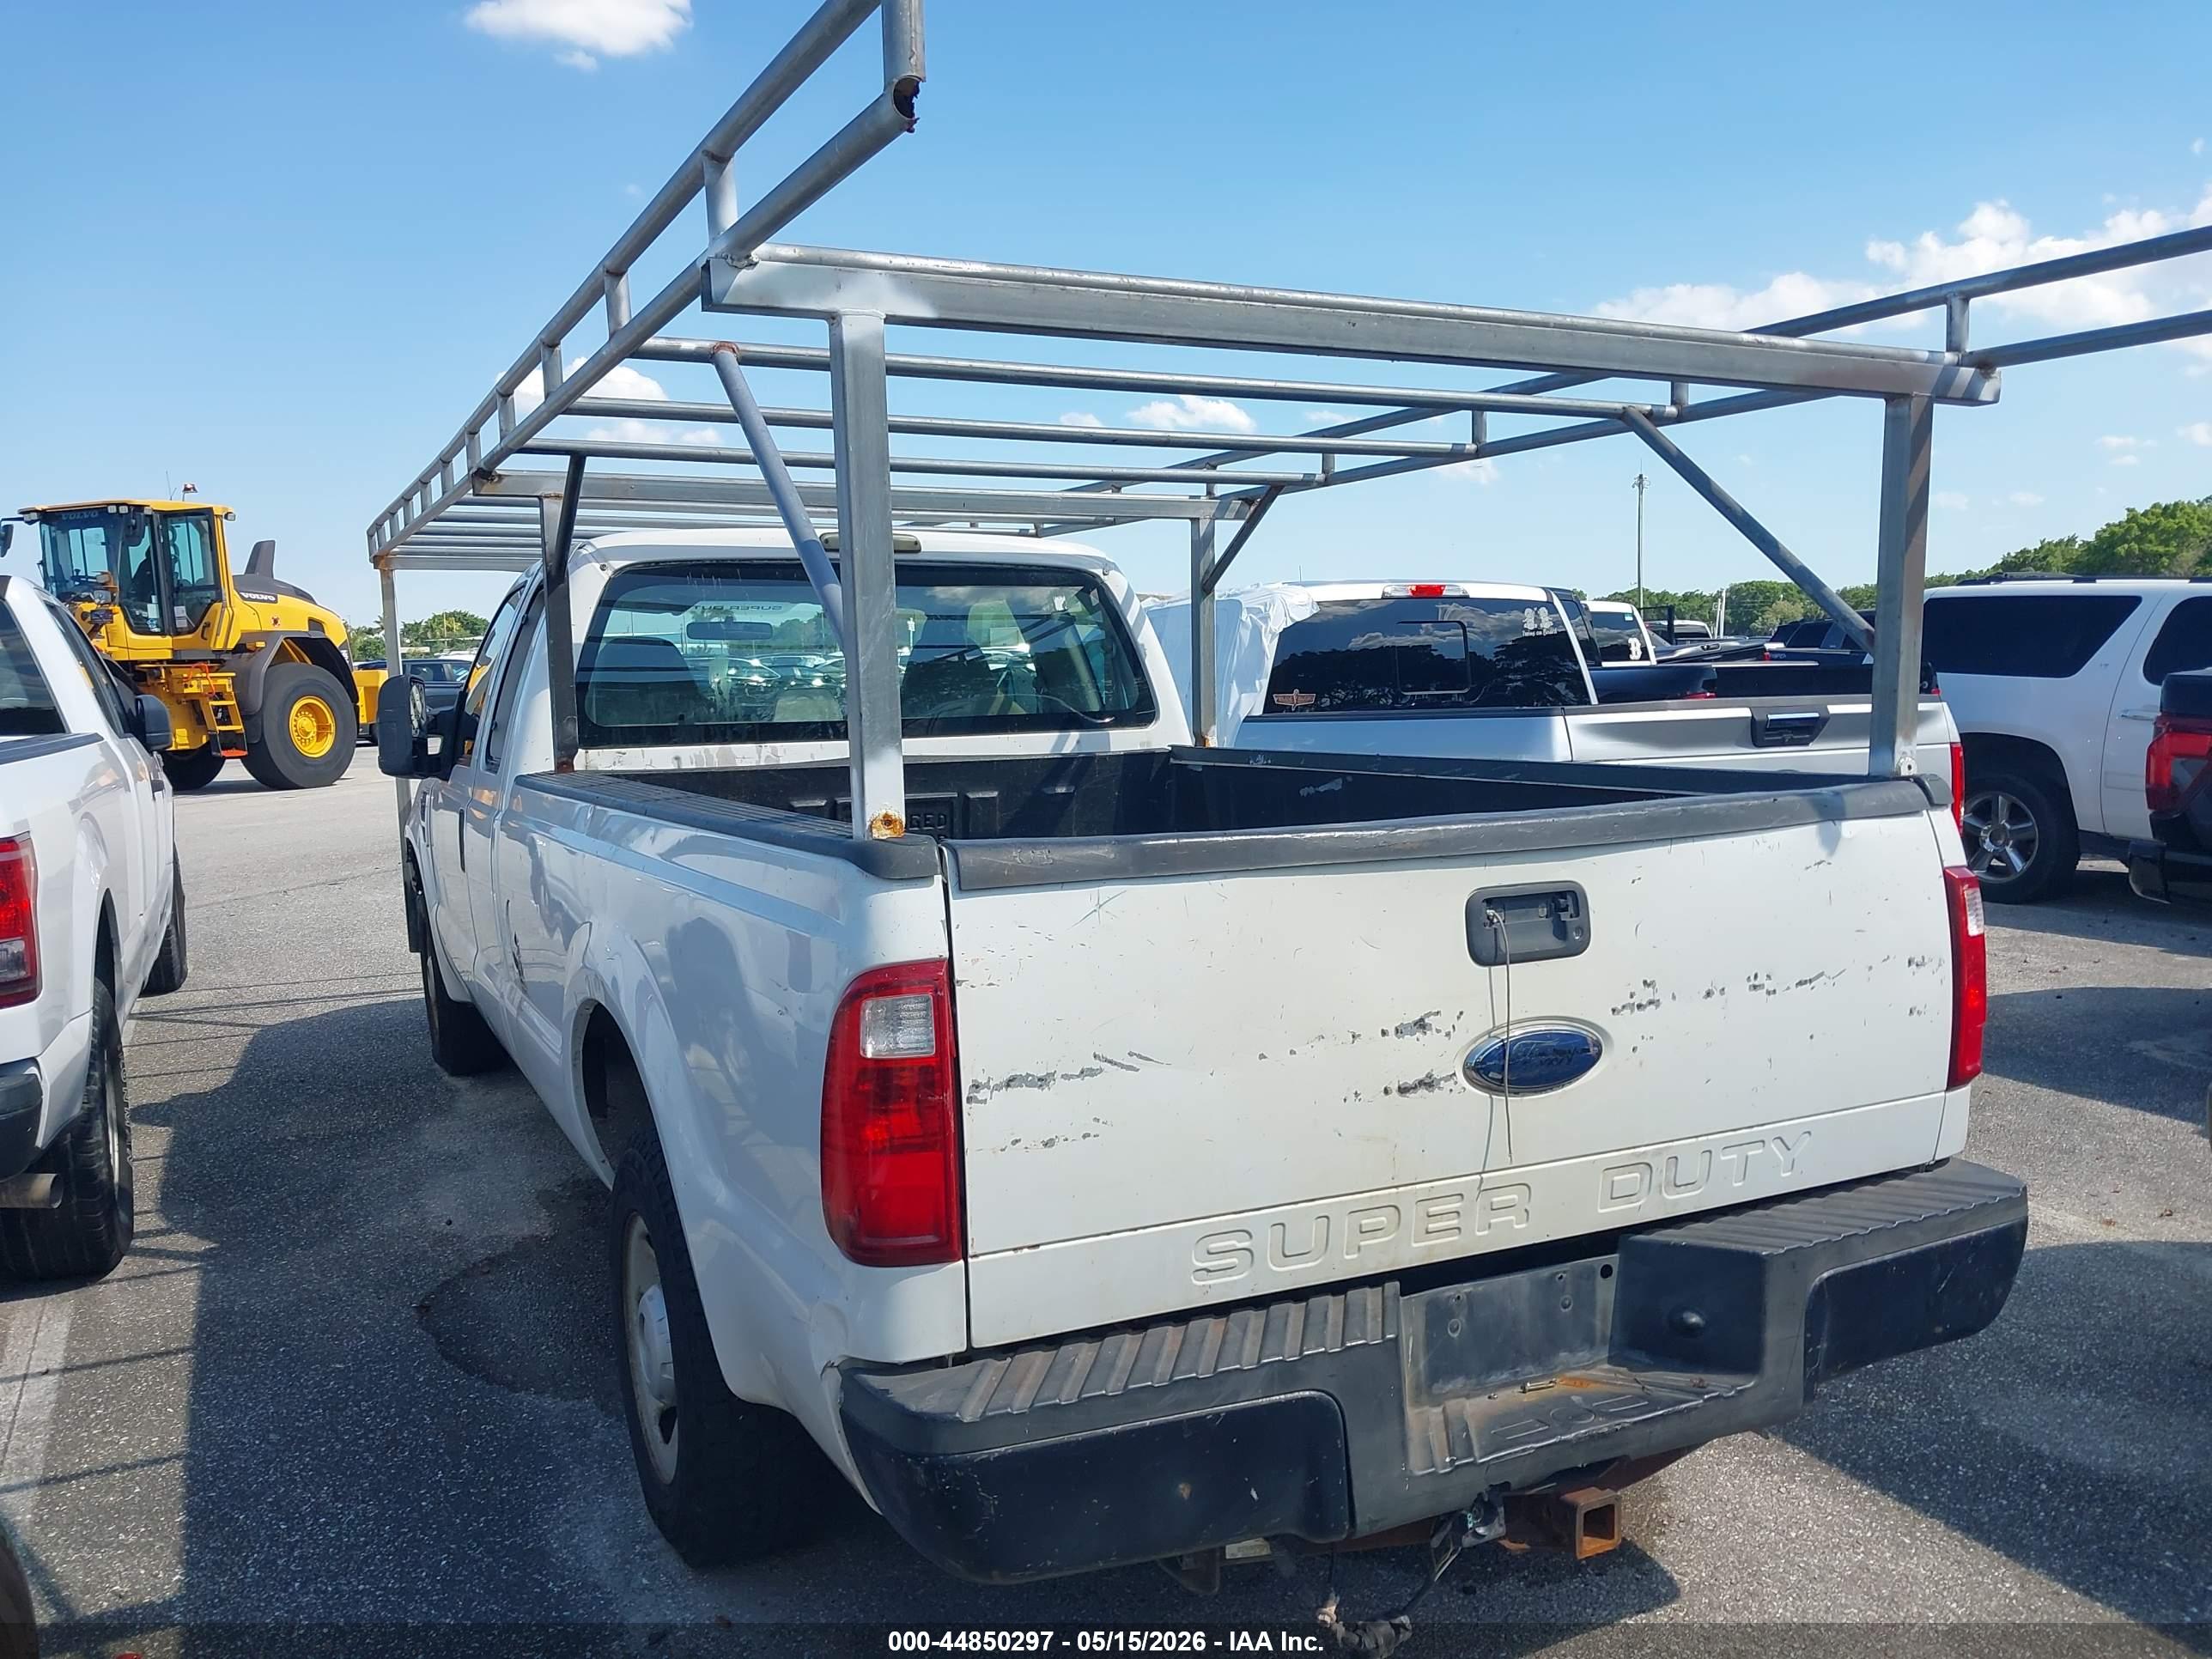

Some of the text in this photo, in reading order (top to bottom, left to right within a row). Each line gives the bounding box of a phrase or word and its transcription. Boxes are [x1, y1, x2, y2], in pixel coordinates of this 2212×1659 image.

[61, 511, 99, 520] VOLVO
[240, 592, 276, 601] VOLVO
[1627, 637, 1642, 660] B
[908, 814, 947, 830] GED
[1191, 1130, 1812, 1285] SUPER DUTY
